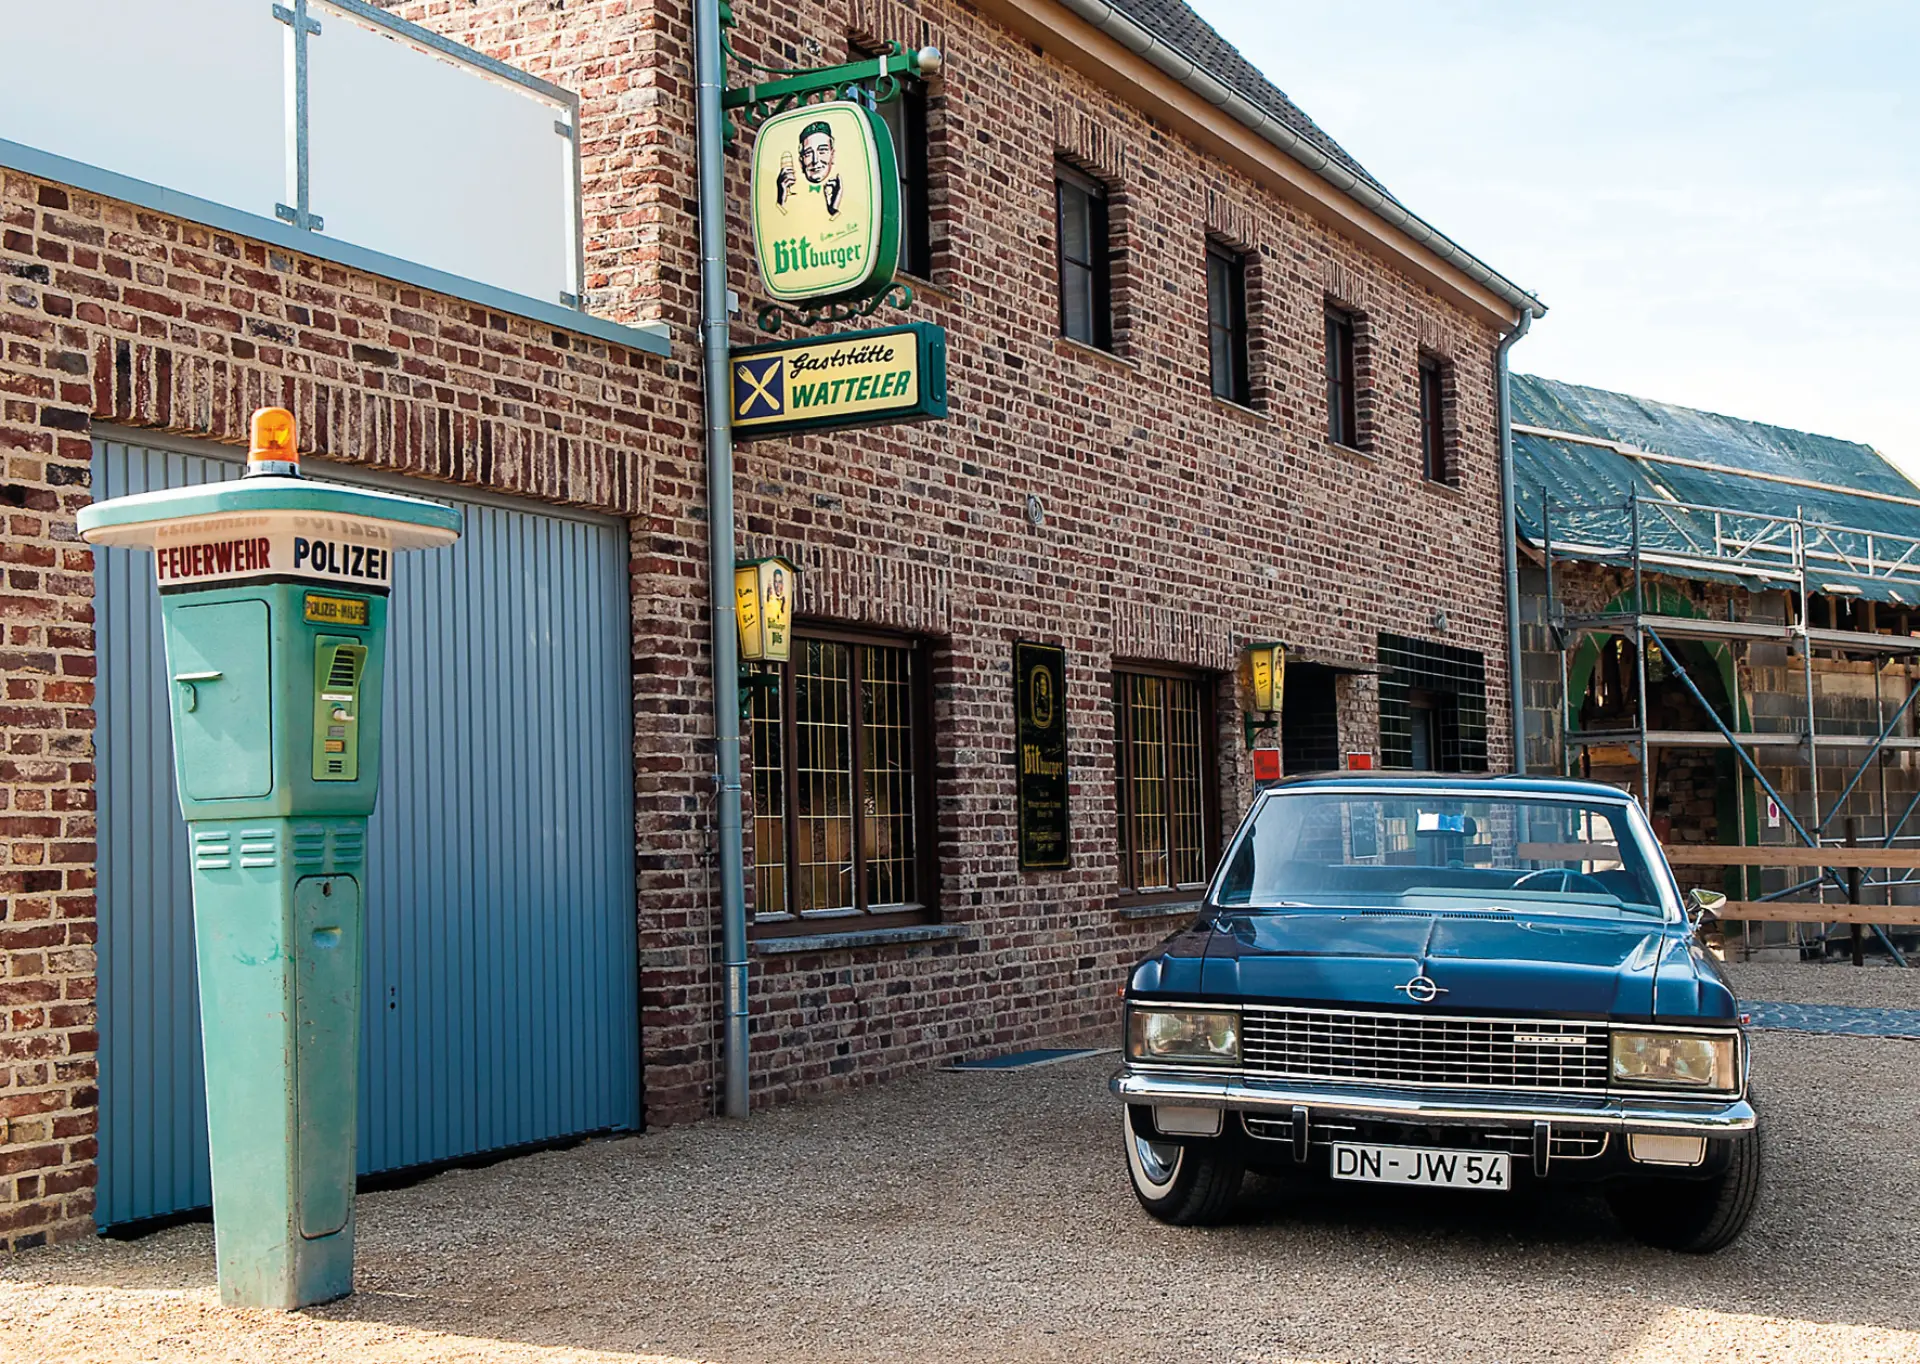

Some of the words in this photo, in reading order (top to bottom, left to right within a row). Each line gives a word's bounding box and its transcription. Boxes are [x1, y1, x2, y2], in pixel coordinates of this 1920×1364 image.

[789, 344, 894, 379] Gaststätte
[792, 370, 911, 409] WATTELER
[157, 537, 271, 580] FEUERWEHR
[294, 536, 388, 580] POLIZEI
[1466, 1156, 1503, 1186] 54
